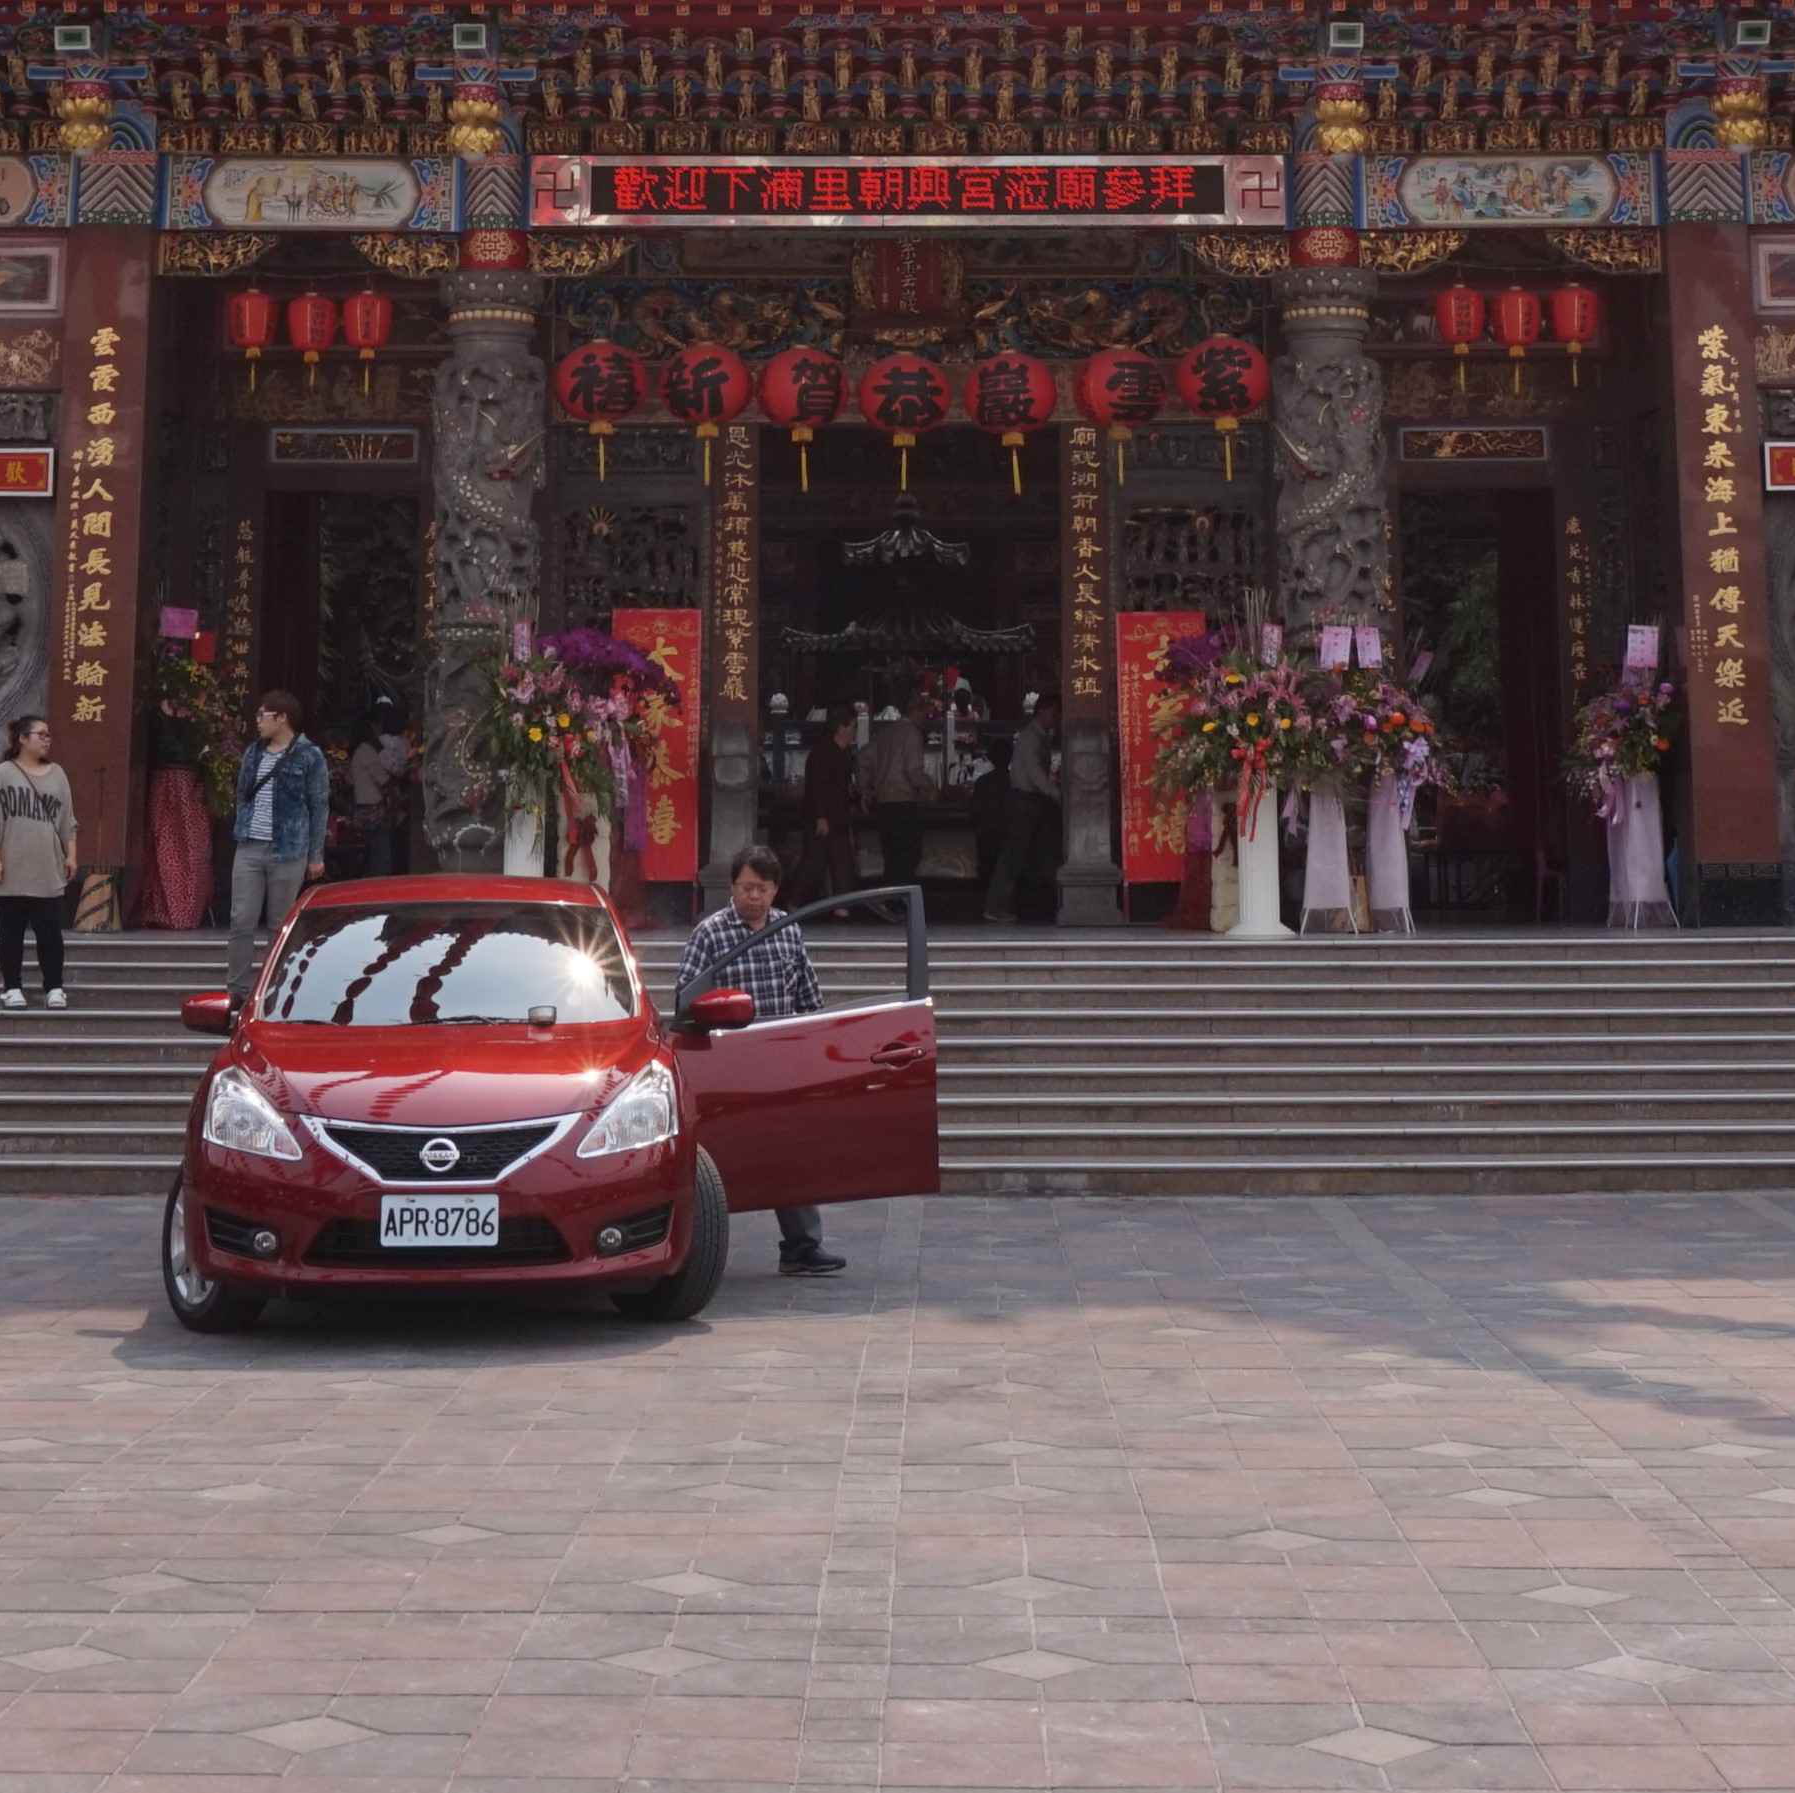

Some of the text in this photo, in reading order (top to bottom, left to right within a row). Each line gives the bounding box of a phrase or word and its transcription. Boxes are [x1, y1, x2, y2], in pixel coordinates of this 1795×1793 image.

[1143, 635, 1190, 855] 大家禧
[420, 1150, 460, 1161] NISSAN
